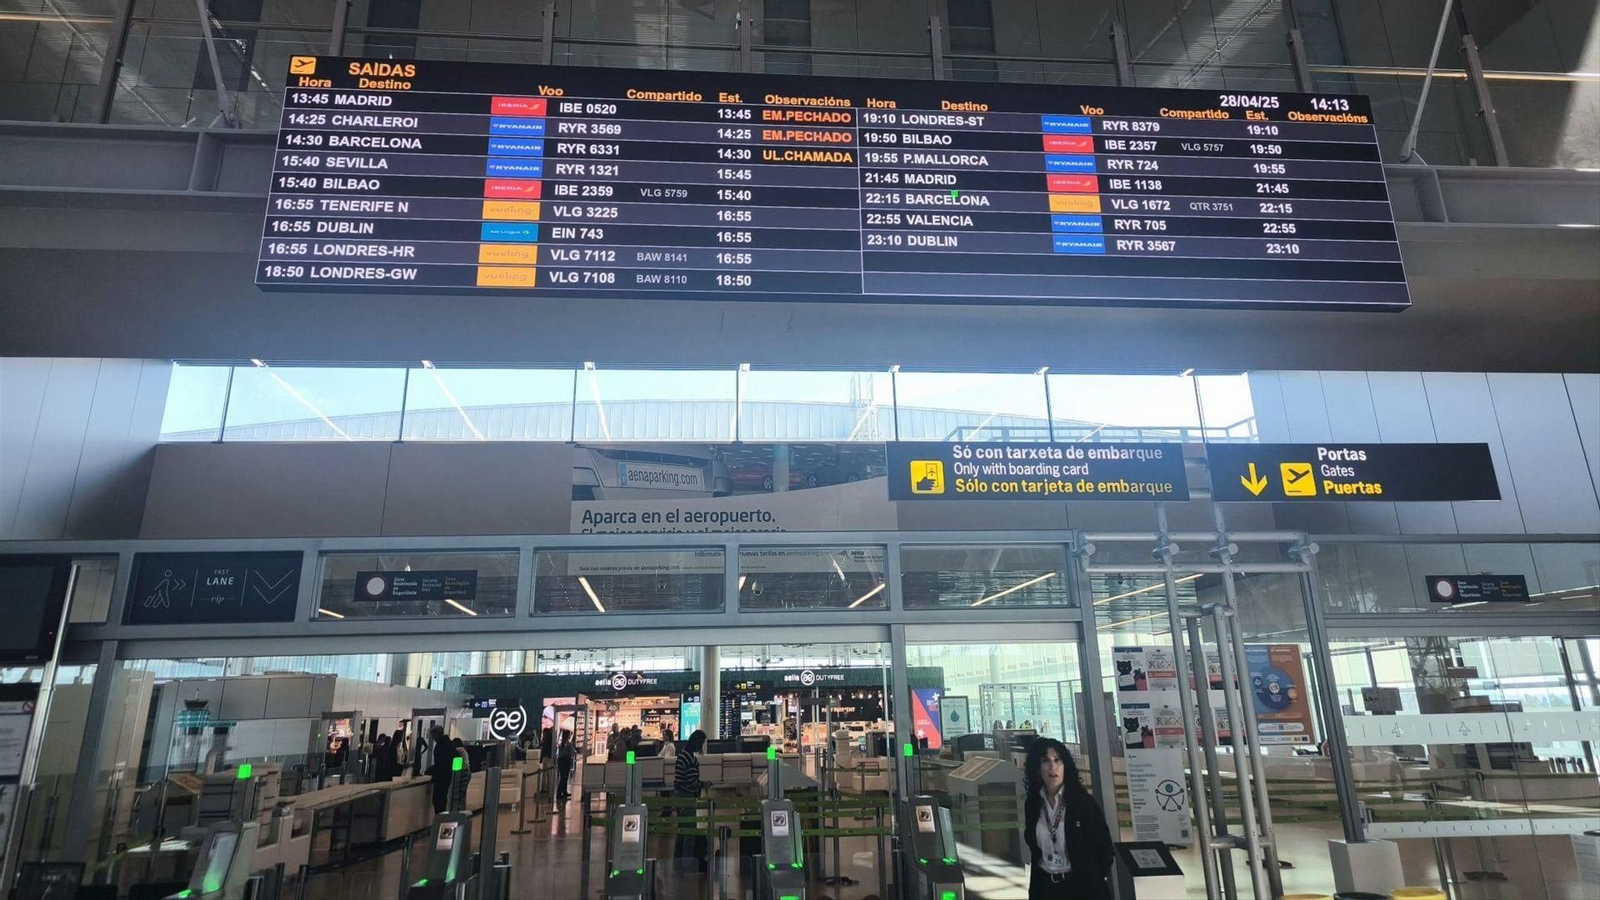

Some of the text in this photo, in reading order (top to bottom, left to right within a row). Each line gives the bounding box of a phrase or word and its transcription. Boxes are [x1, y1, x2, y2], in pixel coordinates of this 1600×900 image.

[298, 77, 850, 108] Hora Destino Voo Compartido Est. Observacións
[1220, 95, 1349, 110] 28/04/25 14:13
[292, 93, 851, 122] 13:45 MADRID IBE 0520 13:45 EM.PECHADO
[867, 98, 1369, 125] Hora Destino Voo Compartido Est. Observacións
[289, 114, 851, 142] 14:25 CHARLEROI RYANAIR RYR 3569 14:25 EM.PECHADO
[864, 113, 1278, 135] 19:10 LONDRES-ST RYANAIR RYR 8379 19:10
[286, 135, 852, 162] 14:30 BARCELONA RYANAIR RYR 6331 14:30 UL.CHAMADA
[865, 133, 1281, 154] 19:50 BILBAO IBE 2357 VLG 5757 19:50
[283, 156, 751, 179] 15:40 SEVILLA RYANAIR RYR 1321 15:45
[865, 153, 1285, 173] 19:55 P.MALLORCA RYANAIR RYR 724 19:55
[279, 177, 751, 200] 15:40 BILBAO IBE 2359 VLG 5759 15:40
[866, 173, 1289, 193] 21:45 MADRID IBE 1138 21:45
[276, 199, 751, 221] 16:55 TENERIFE N VLG 3225 16:55
[866, 193, 1292, 213] 22:15 BARCELONA VLG 1672 QTR 3751 22:15
[273, 221, 751, 242] 16:55 DUBLIN EIN 743 16:55
[867, 214, 1296, 233] 22:55 VALENCIA RYANAIR RYR 705 22:55
[269, 243, 751, 264] 16:55 LONDRES-HR VLG 7112 BAW 8141 16:55
[868, 235, 1299, 254] 23:10 DUBLIN RYANAIR RYR 3567 23:10
[265, 266, 751, 286] 18:50 LONDRES-GW VLG 7108 BAW 8110 18:50
[953, 445, 1162, 461] Só con tarxeta de embarque
[1317, 447, 1366, 460] Portas
[629, 470, 699, 486] aenaparking.com
[954, 462, 1089, 477] Only with boarding card
[1321, 464, 1354, 476] Gates
[956, 479, 1172, 495] Sólo con tarjeta de embarque
[1324, 480, 1382, 494] Puertas
[582, 509, 775, 527] Aparca en el aeropuerto.
[206, 576, 234, 586] LANE
